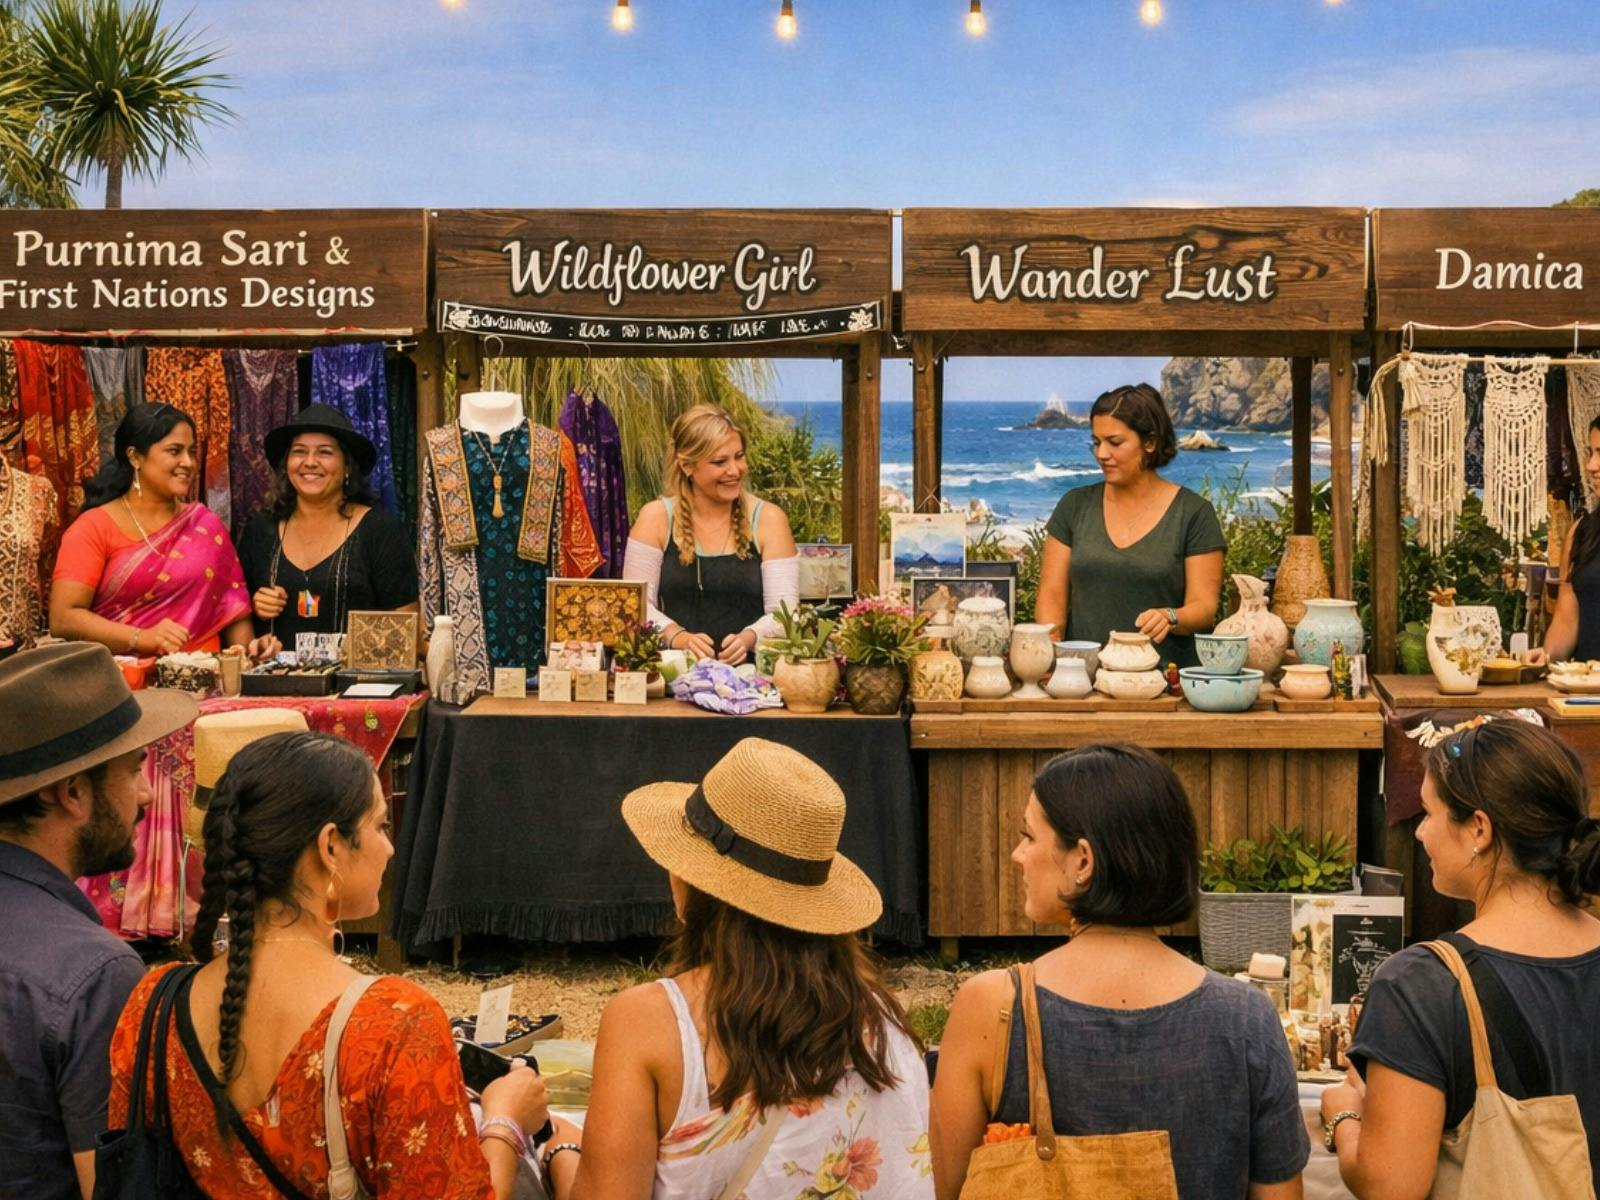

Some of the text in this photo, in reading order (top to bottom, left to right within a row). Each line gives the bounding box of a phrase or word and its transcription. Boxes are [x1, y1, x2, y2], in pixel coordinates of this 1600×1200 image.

[13, 229, 350, 267] Purnima Sari &
[1435, 248, 1583, 290] Damica
[502, 240, 817, 311] Wildflower Girl
[960, 244, 1277, 302] Wander Lust
[0, 277, 375, 319] First Nations Designs
